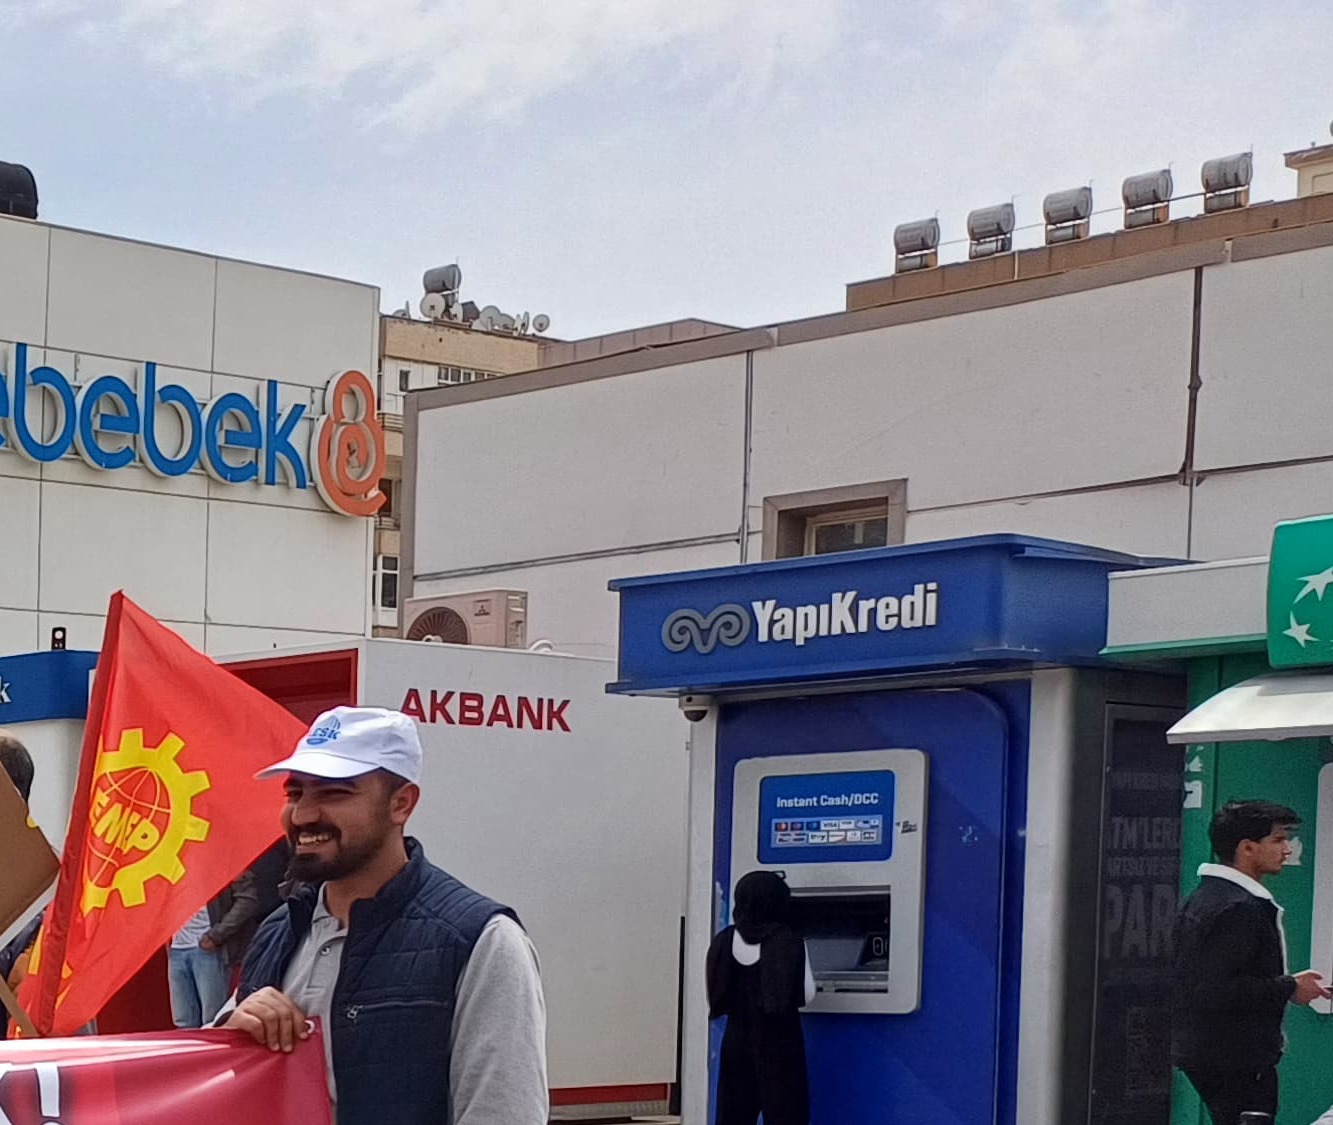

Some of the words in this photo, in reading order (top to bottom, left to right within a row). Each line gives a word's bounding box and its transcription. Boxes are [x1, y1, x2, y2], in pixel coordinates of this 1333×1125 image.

[401, 687, 572, 734] AKBANK
[776, 796, 818, 808] Instant
[820, 793, 879, 807] Cash/DCC
